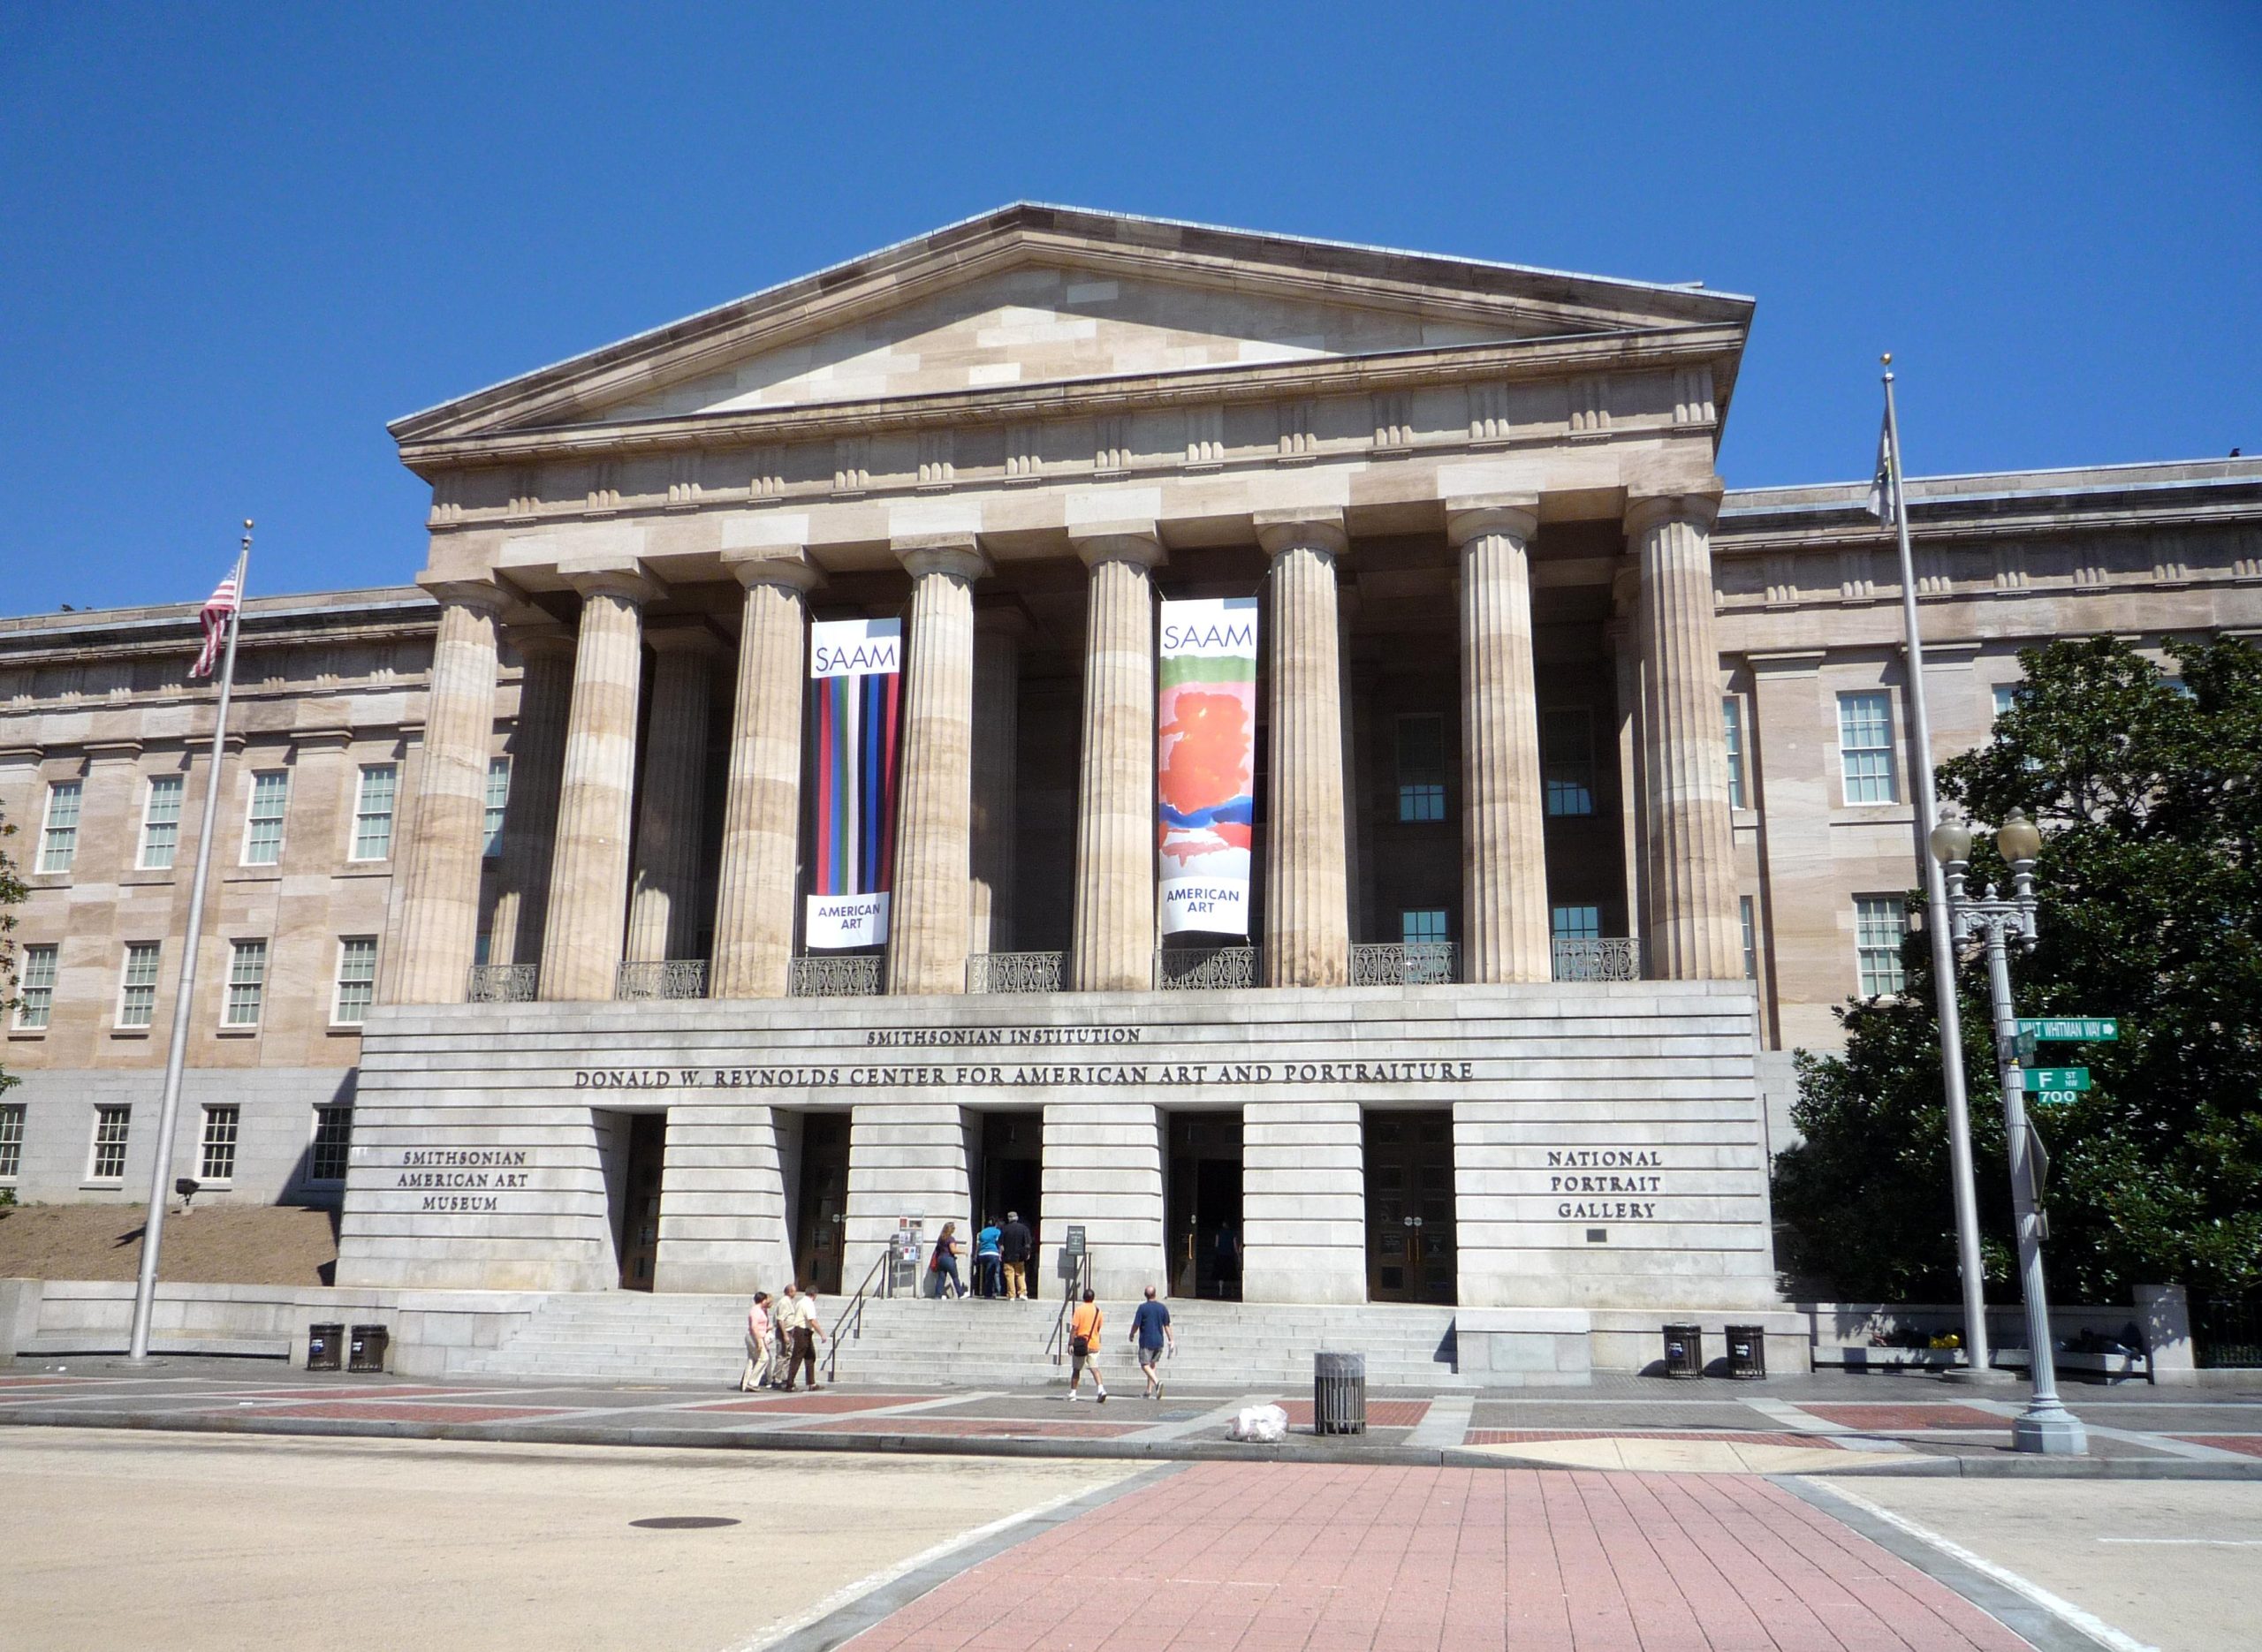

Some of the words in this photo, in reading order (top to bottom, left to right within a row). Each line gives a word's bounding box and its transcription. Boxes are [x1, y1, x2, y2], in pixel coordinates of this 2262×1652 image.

[1164, 623, 1252, 649] SAAM
[816, 643, 895, 671] SAAM
[1167, 888, 1239, 901] AMERICAN
[818, 903, 881, 917] AMERICAN
[1188, 901, 1215, 913] ART
[841, 918, 862, 929] ART
[2043, 1021, 2082, 1037] WHITMAN
[2084, 1021, 2100, 1037] WAY
[867, 1029, 1002, 1046] SMITHSONIAN
[1010, 1028, 1141, 1045] INSTITUTION
[575, 1071, 671, 1087] DONALD
[681, 1071, 703, 1088] W.
[714, 1069, 839, 1087] REYNOLDS
[850, 1068, 946, 1086] CENTER
[955, 1067, 1005, 1085] FOR
[1014, 1066, 1148, 1085] AMERICAN
[1159, 1065, 1208, 1084] ART
[1218, 1065, 1271, 1083] AND
[1283, 1063, 1474, 1083] PORTRAITURE
[2038, 1072, 2053, 1087] F
[2039, 1090, 2076, 1103] 700
[403, 1151, 526, 1165] SMITHSONIAN
[1547, 1151, 1662, 1166] NATIONAL
[398, 1173, 489, 1187] AMERICAN
[495, 1174, 528, 1187] ART
[1551, 1177, 1660, 1192] PORTRAIT
[422, 1197, 497, 1210] MUSEUM
[1558, 1202, 1655, 1218] GALLERY
